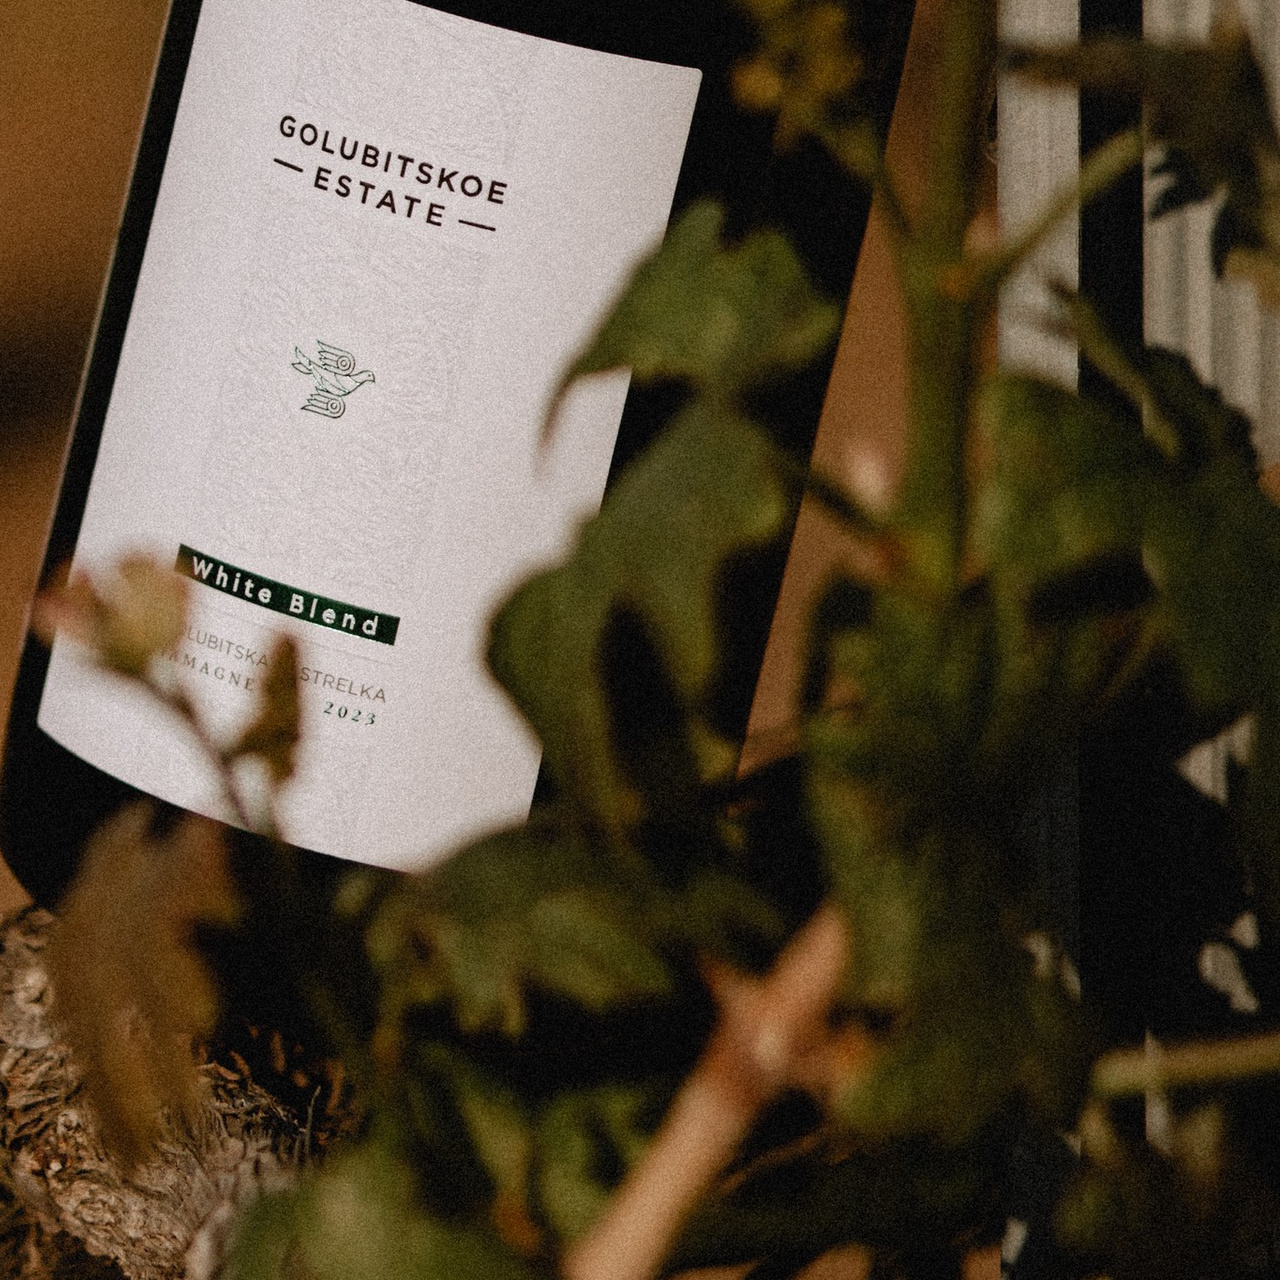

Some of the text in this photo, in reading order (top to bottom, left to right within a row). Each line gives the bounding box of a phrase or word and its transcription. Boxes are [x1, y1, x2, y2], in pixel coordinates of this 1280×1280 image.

[279, 115, 507, 204] GOLUBITSKOE
[314, 166, 445, 227] ESTATE
[192, 556, 379, 637] White Blend
[169, 651, 376, 726] MAGNE 2023
[187, 625, 386, 703] LUBITSKA STRELKA
